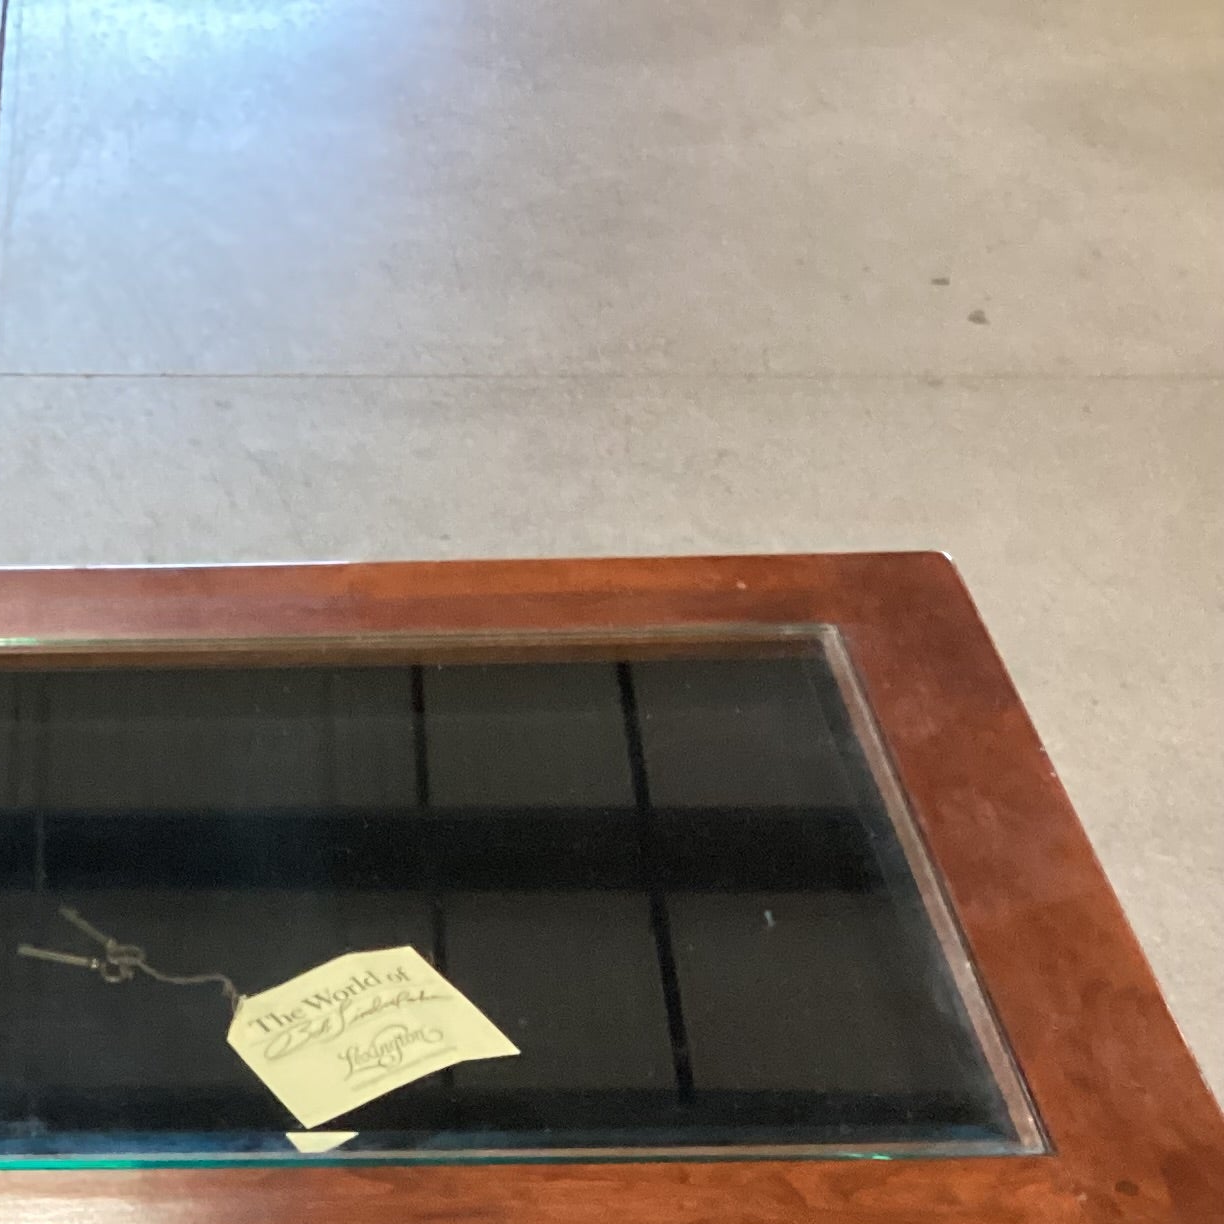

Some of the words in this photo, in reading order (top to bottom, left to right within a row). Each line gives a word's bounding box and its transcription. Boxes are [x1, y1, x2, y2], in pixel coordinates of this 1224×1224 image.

[248, 1005, 305, 1034] The
[302, 970, 383, 1012] World
[386, 966, 412, 983] of
